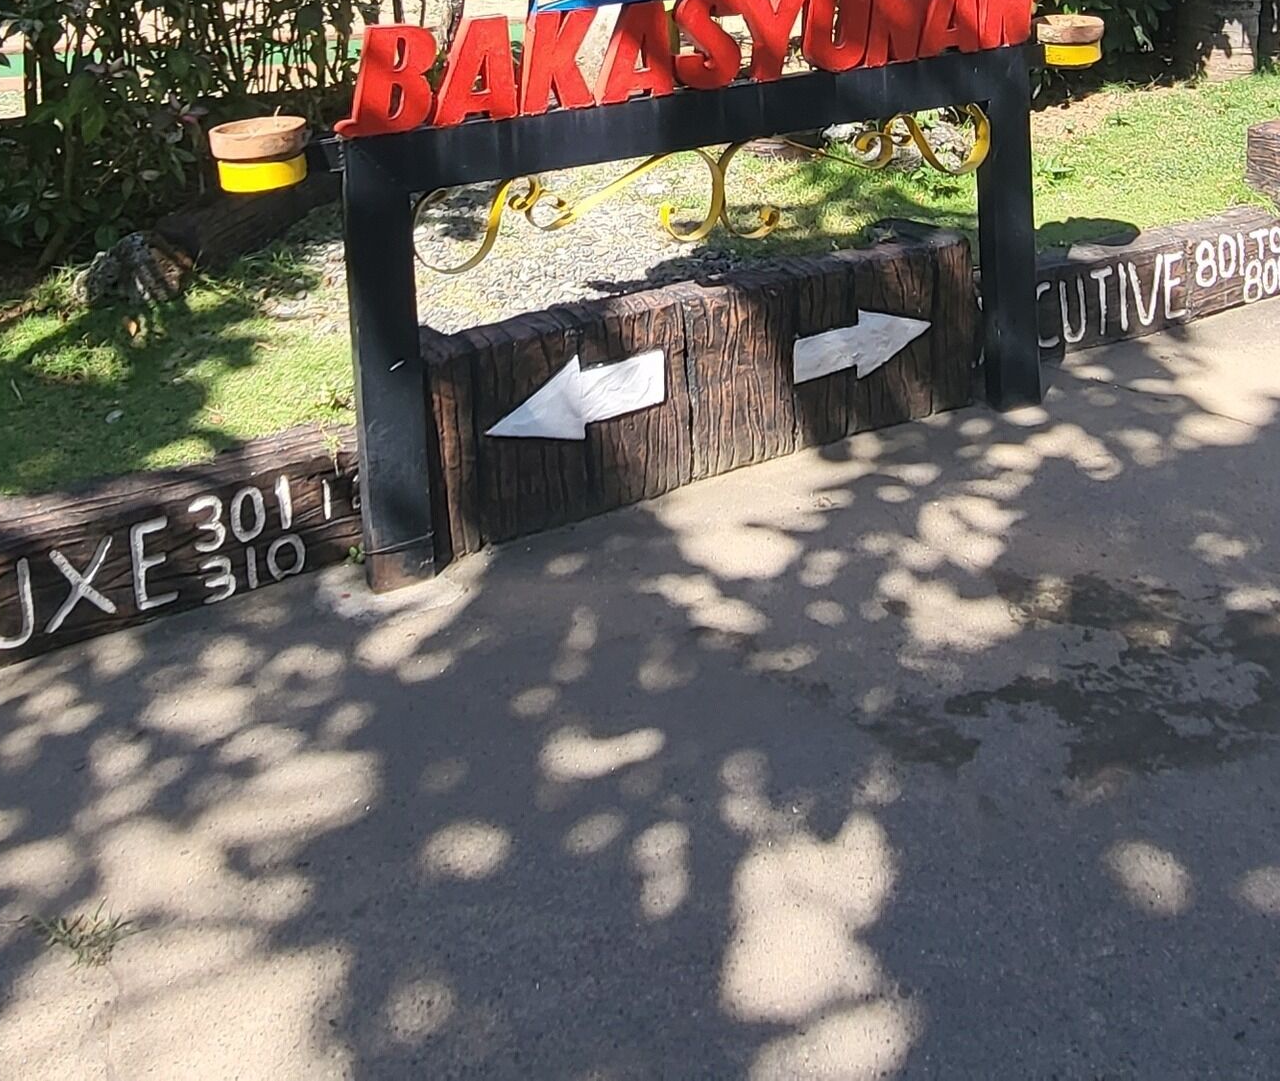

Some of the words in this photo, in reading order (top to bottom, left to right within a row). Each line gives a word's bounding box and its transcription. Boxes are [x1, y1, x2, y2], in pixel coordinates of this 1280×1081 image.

[1035, 249, 1188, 349] CUTIVE
[1194, 233, 1246, 288] 801
[188, 474, 293, 553] 301
[199, 533, 306, 605] 310
